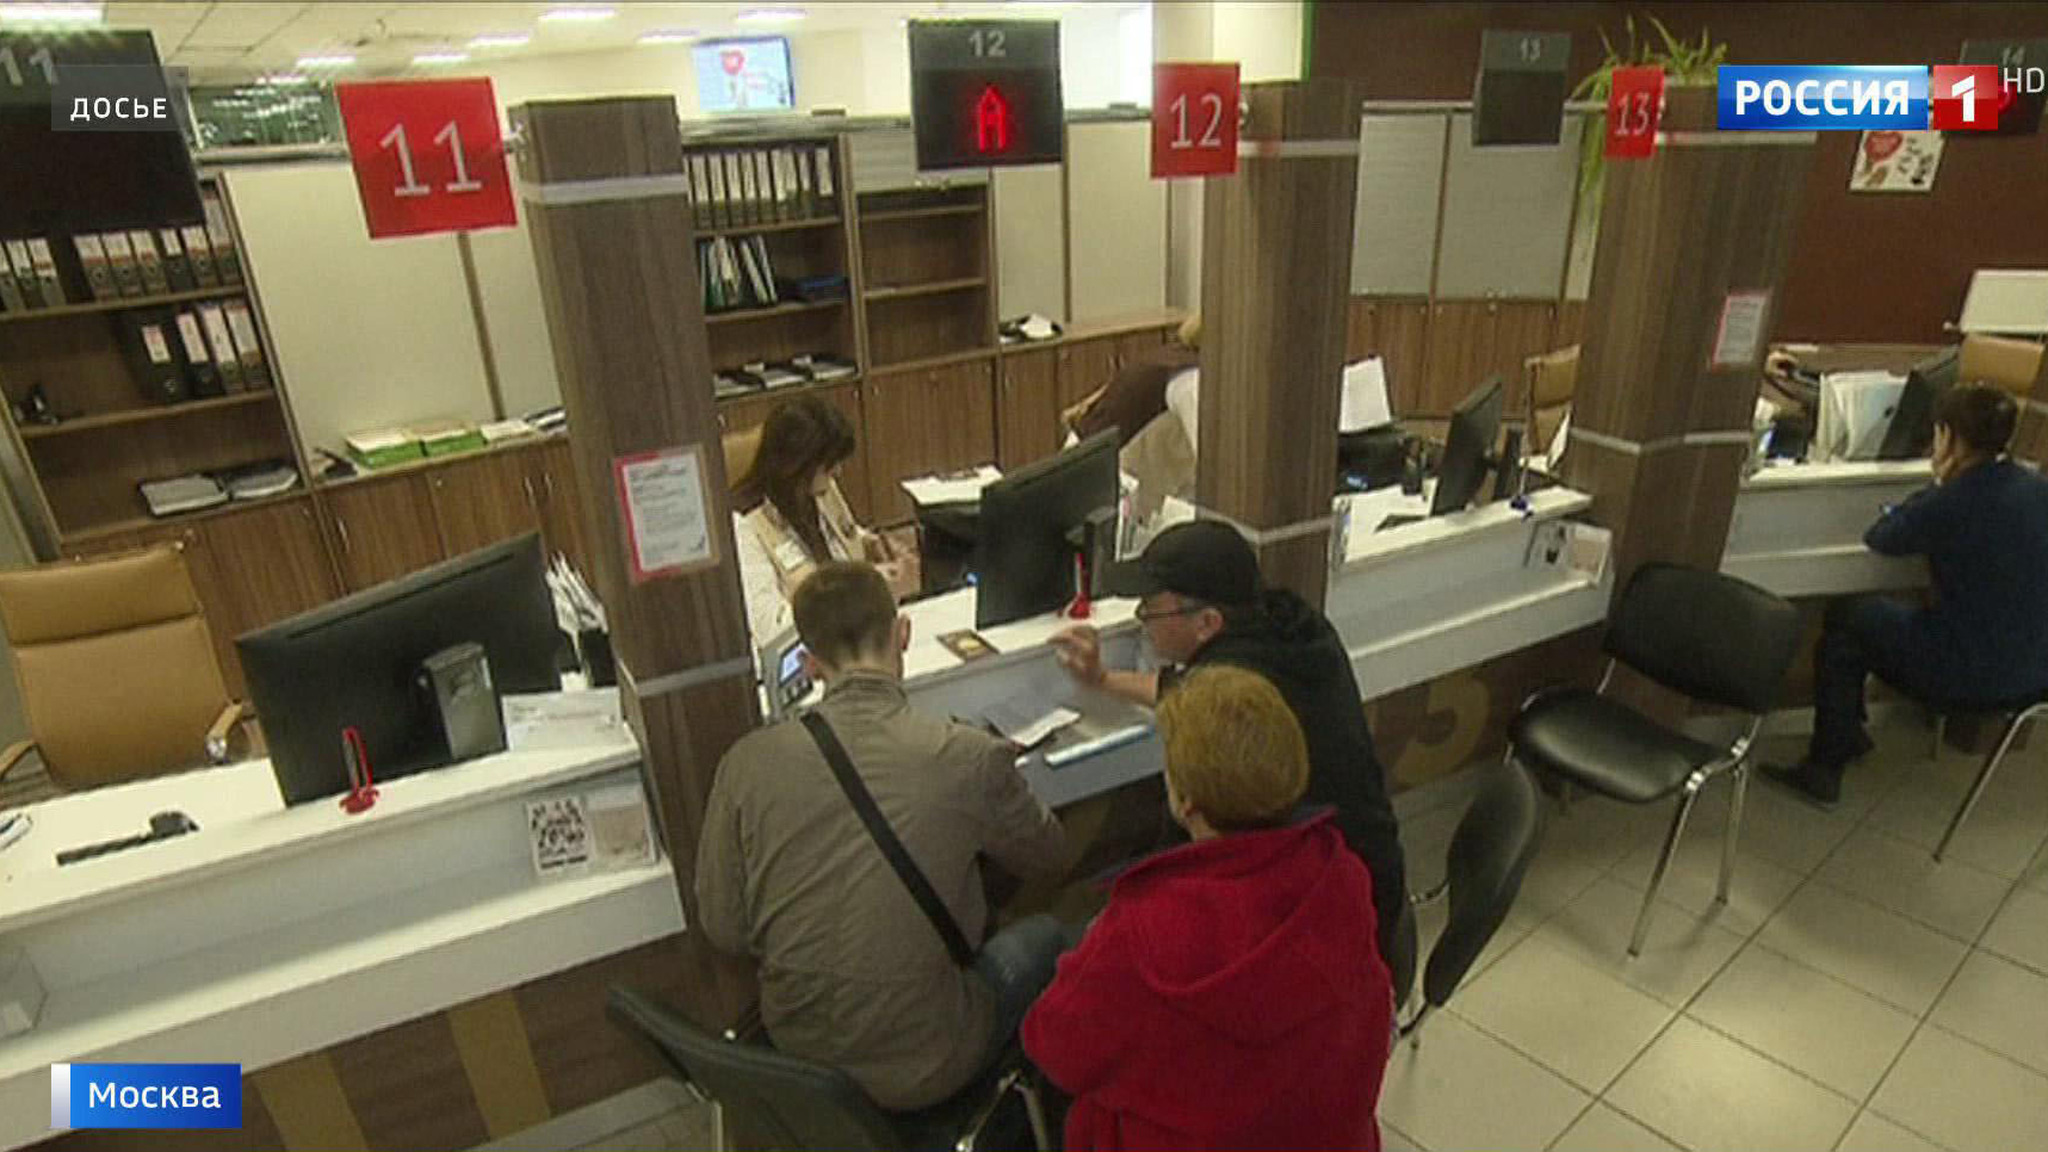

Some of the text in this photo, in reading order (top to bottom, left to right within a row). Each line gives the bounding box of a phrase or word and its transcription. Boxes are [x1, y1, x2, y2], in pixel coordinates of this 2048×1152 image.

[969, 29, 1006, 57] 12
[1170, 93, 1222, 149] 12
[1614, 92, 1650, 136] 13
[380, 120, 482, 197] 11
